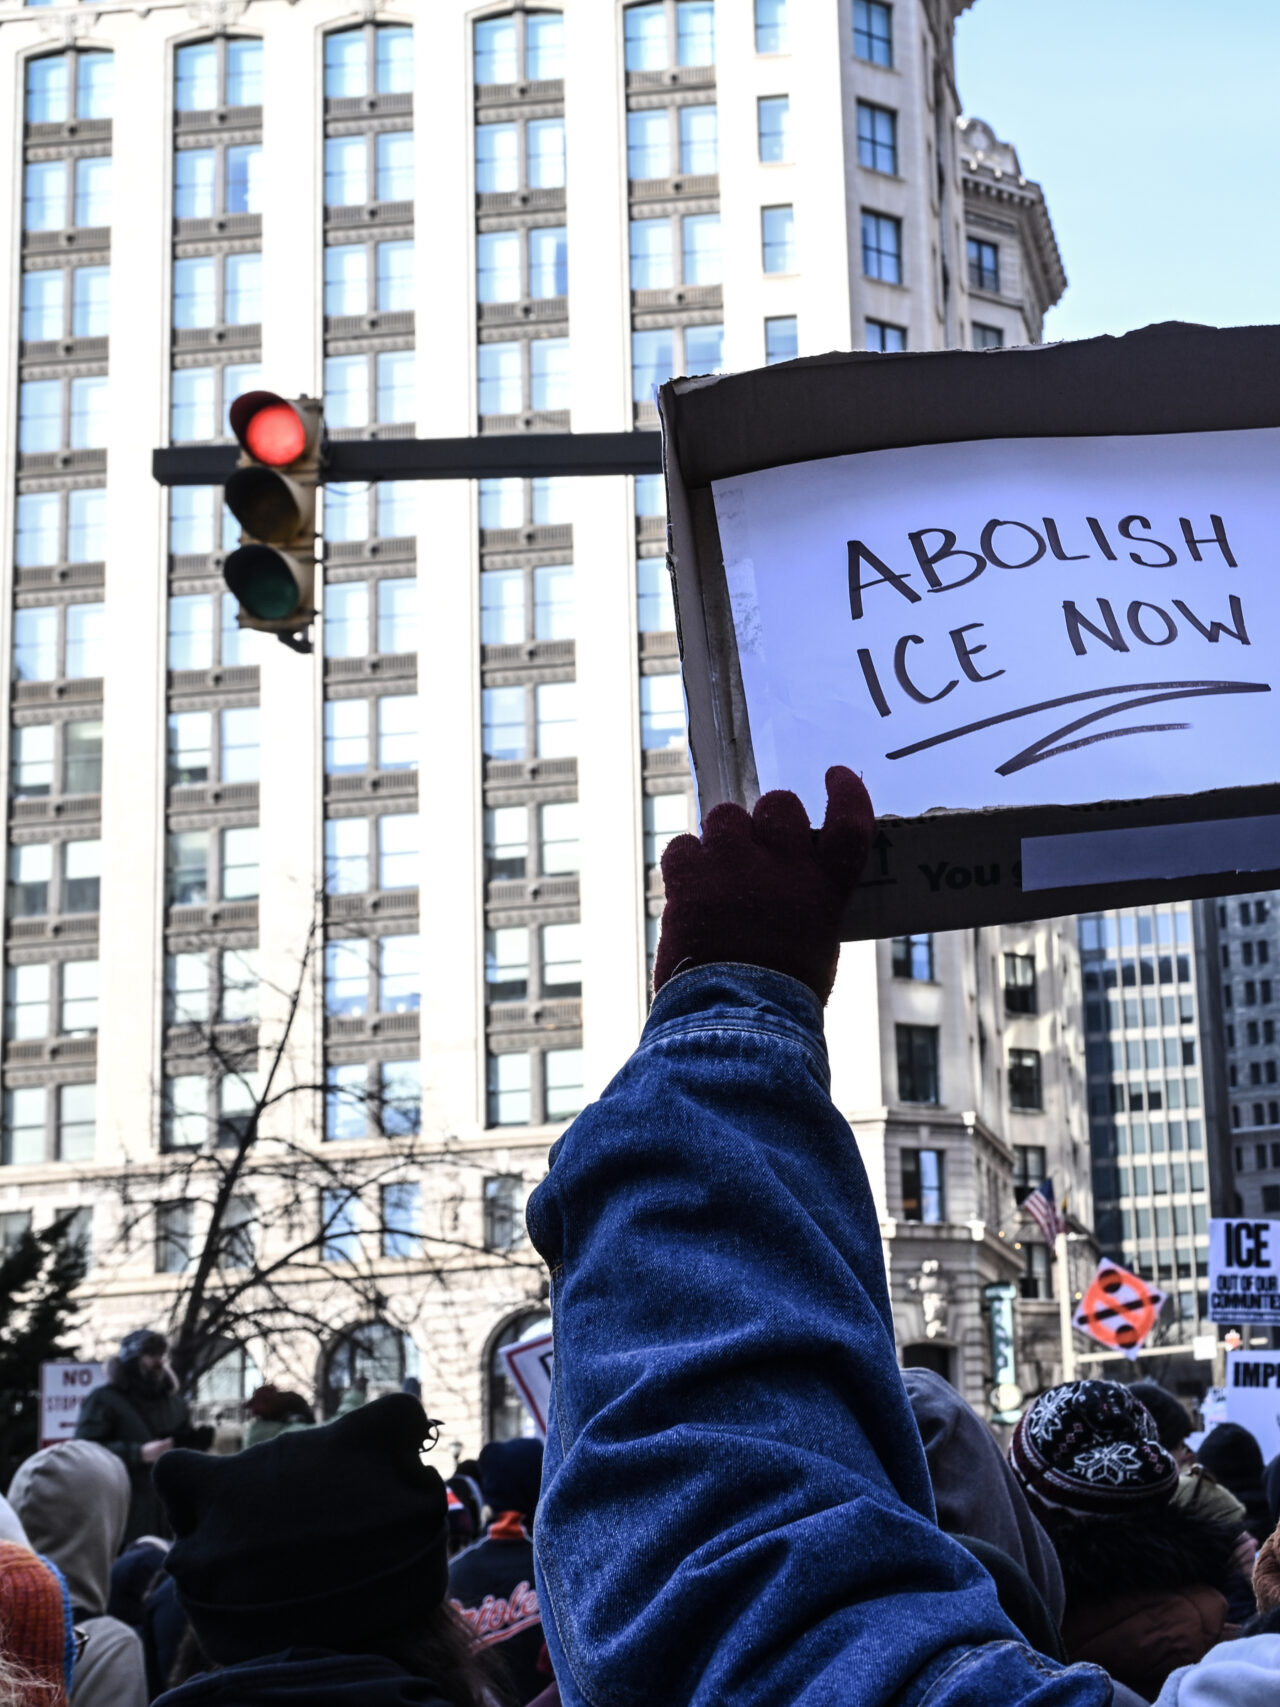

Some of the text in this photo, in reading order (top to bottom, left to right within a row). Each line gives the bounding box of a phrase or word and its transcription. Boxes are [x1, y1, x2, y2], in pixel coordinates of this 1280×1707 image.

[846, 514, 1238, 620] ABOLISH
[856, 594, 1251, 718] ICE NOW
[918, 861, 1001, 892] You
[1225, 1222, 1270, 1268] ICE
[1217, 1275, 1278, 1291] OUT OF OUR
[63, 1368, 93, 1387] NO
